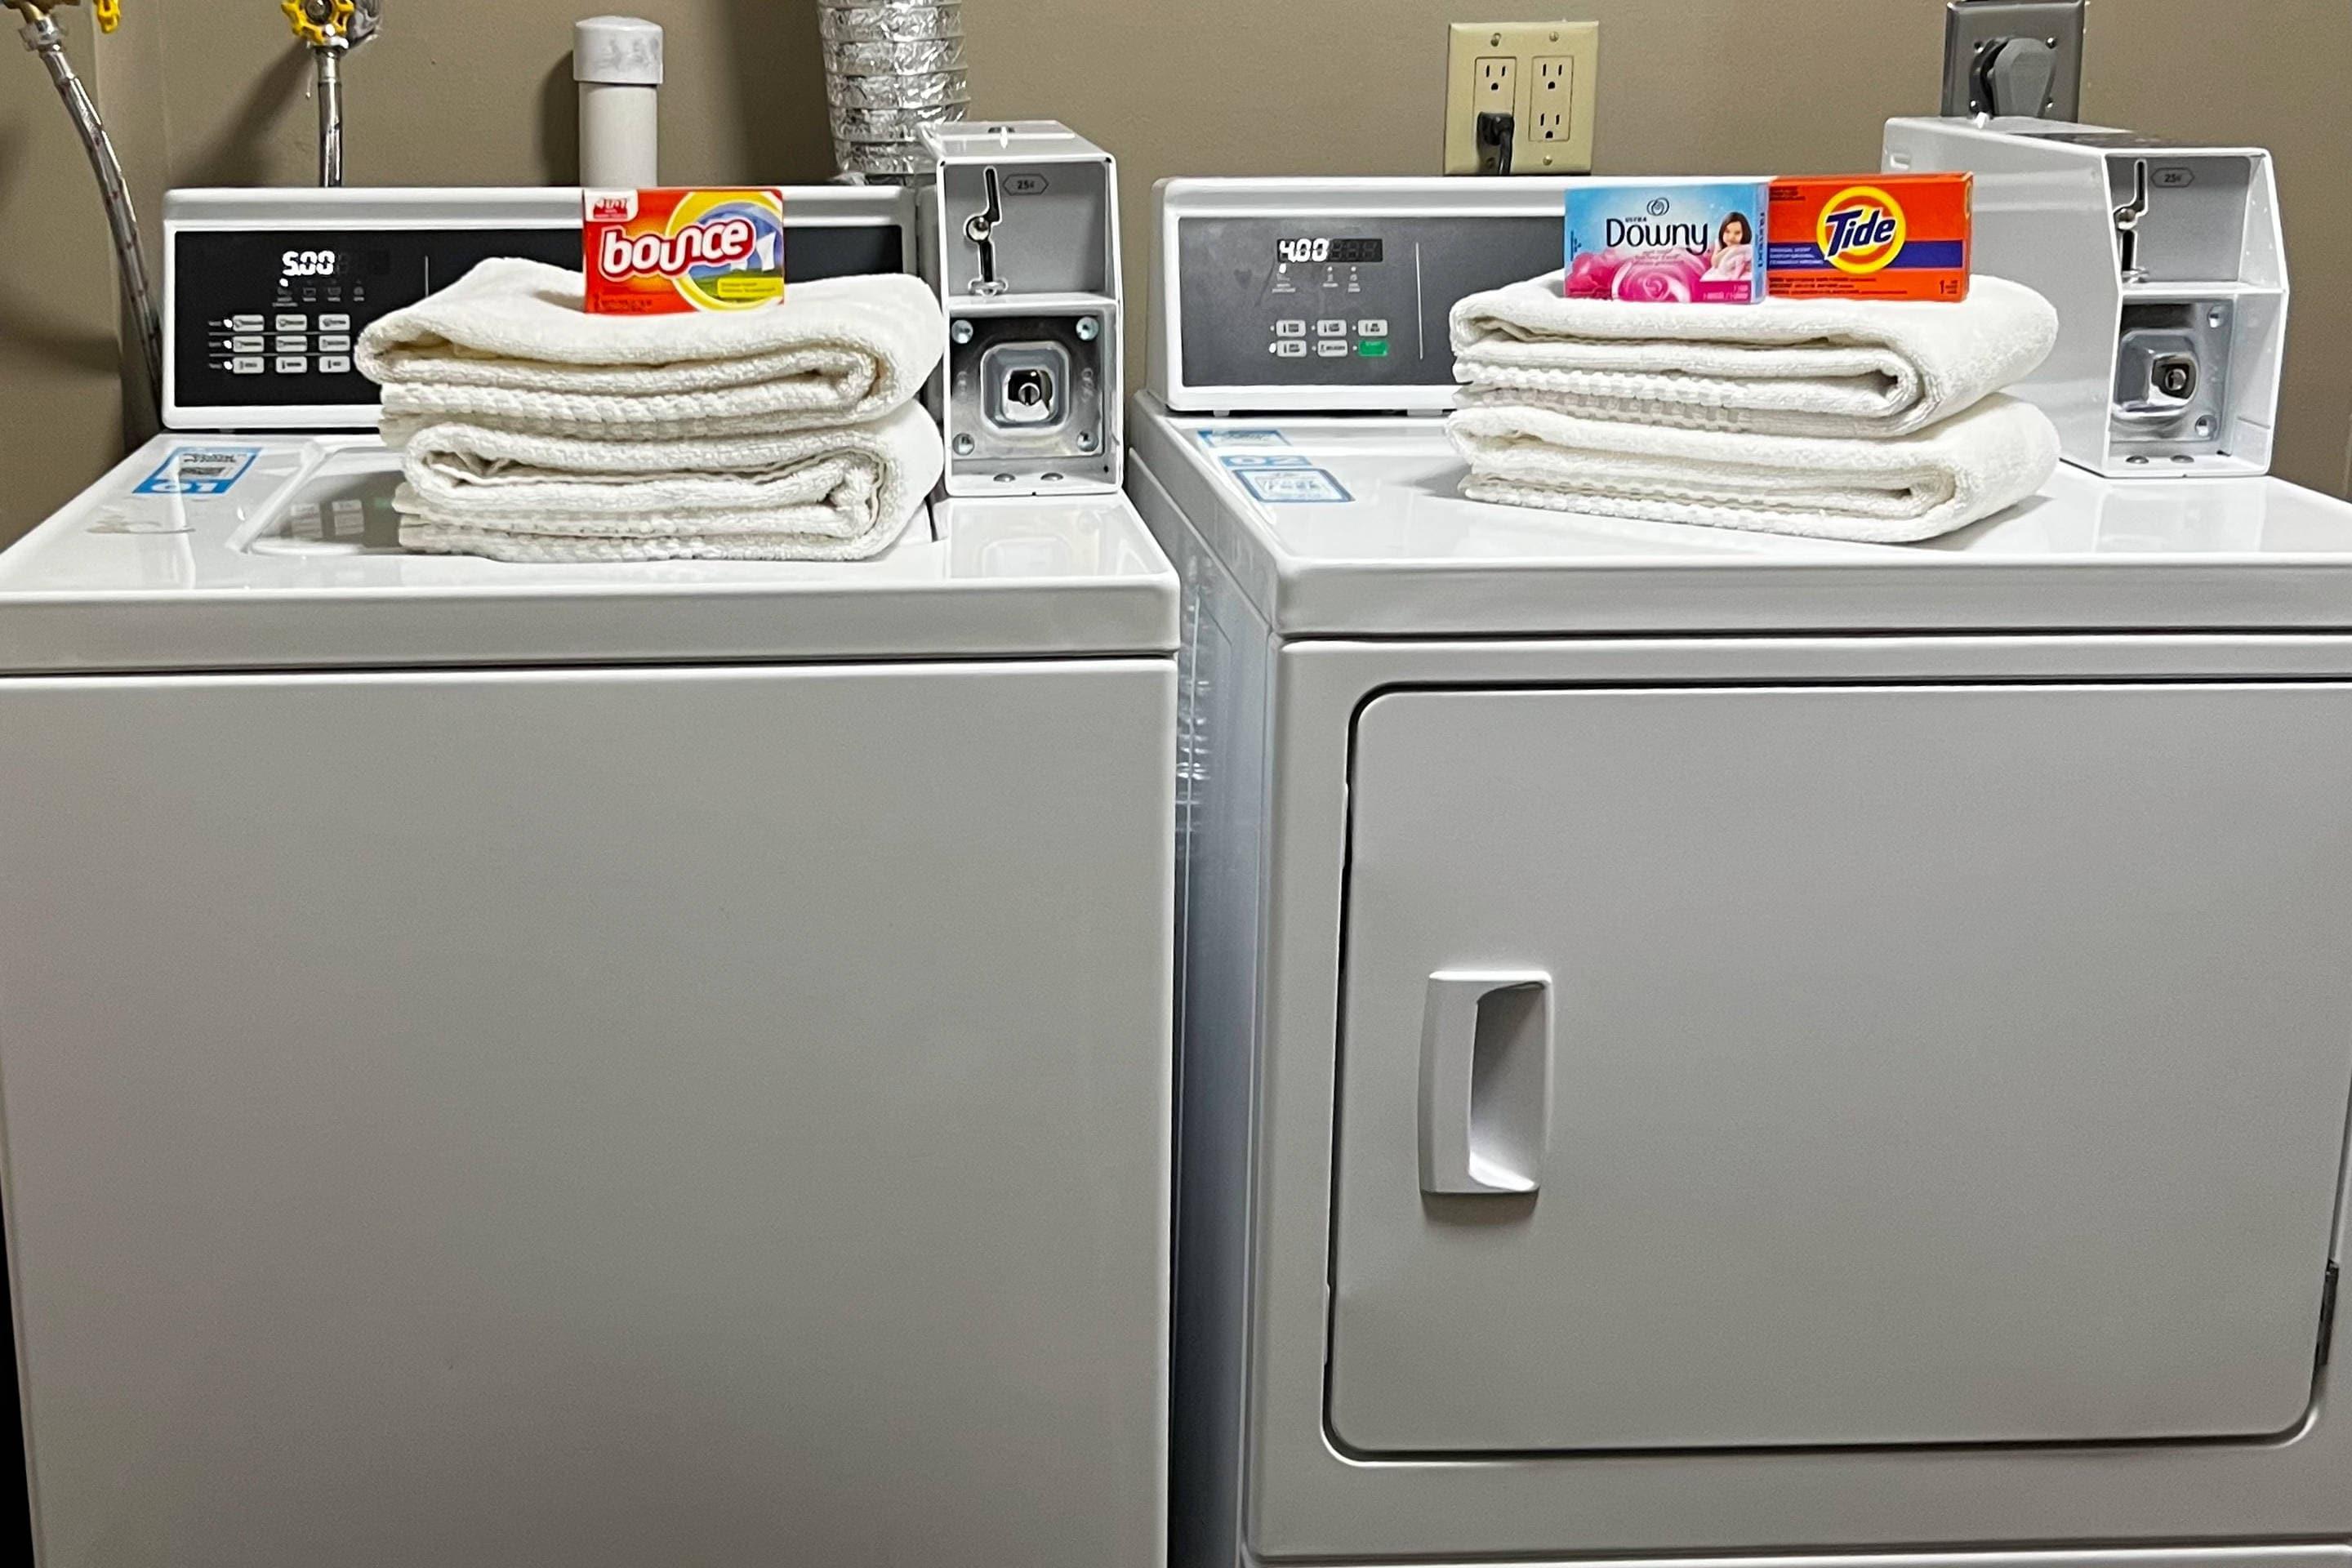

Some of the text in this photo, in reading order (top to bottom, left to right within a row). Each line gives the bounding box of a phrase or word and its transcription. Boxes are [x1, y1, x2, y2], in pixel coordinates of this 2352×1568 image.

[601, 218, 751, 275] bounce
[1606, 218, 1708, 256] Downy
[1825, 208, 1896, 257] Tide
